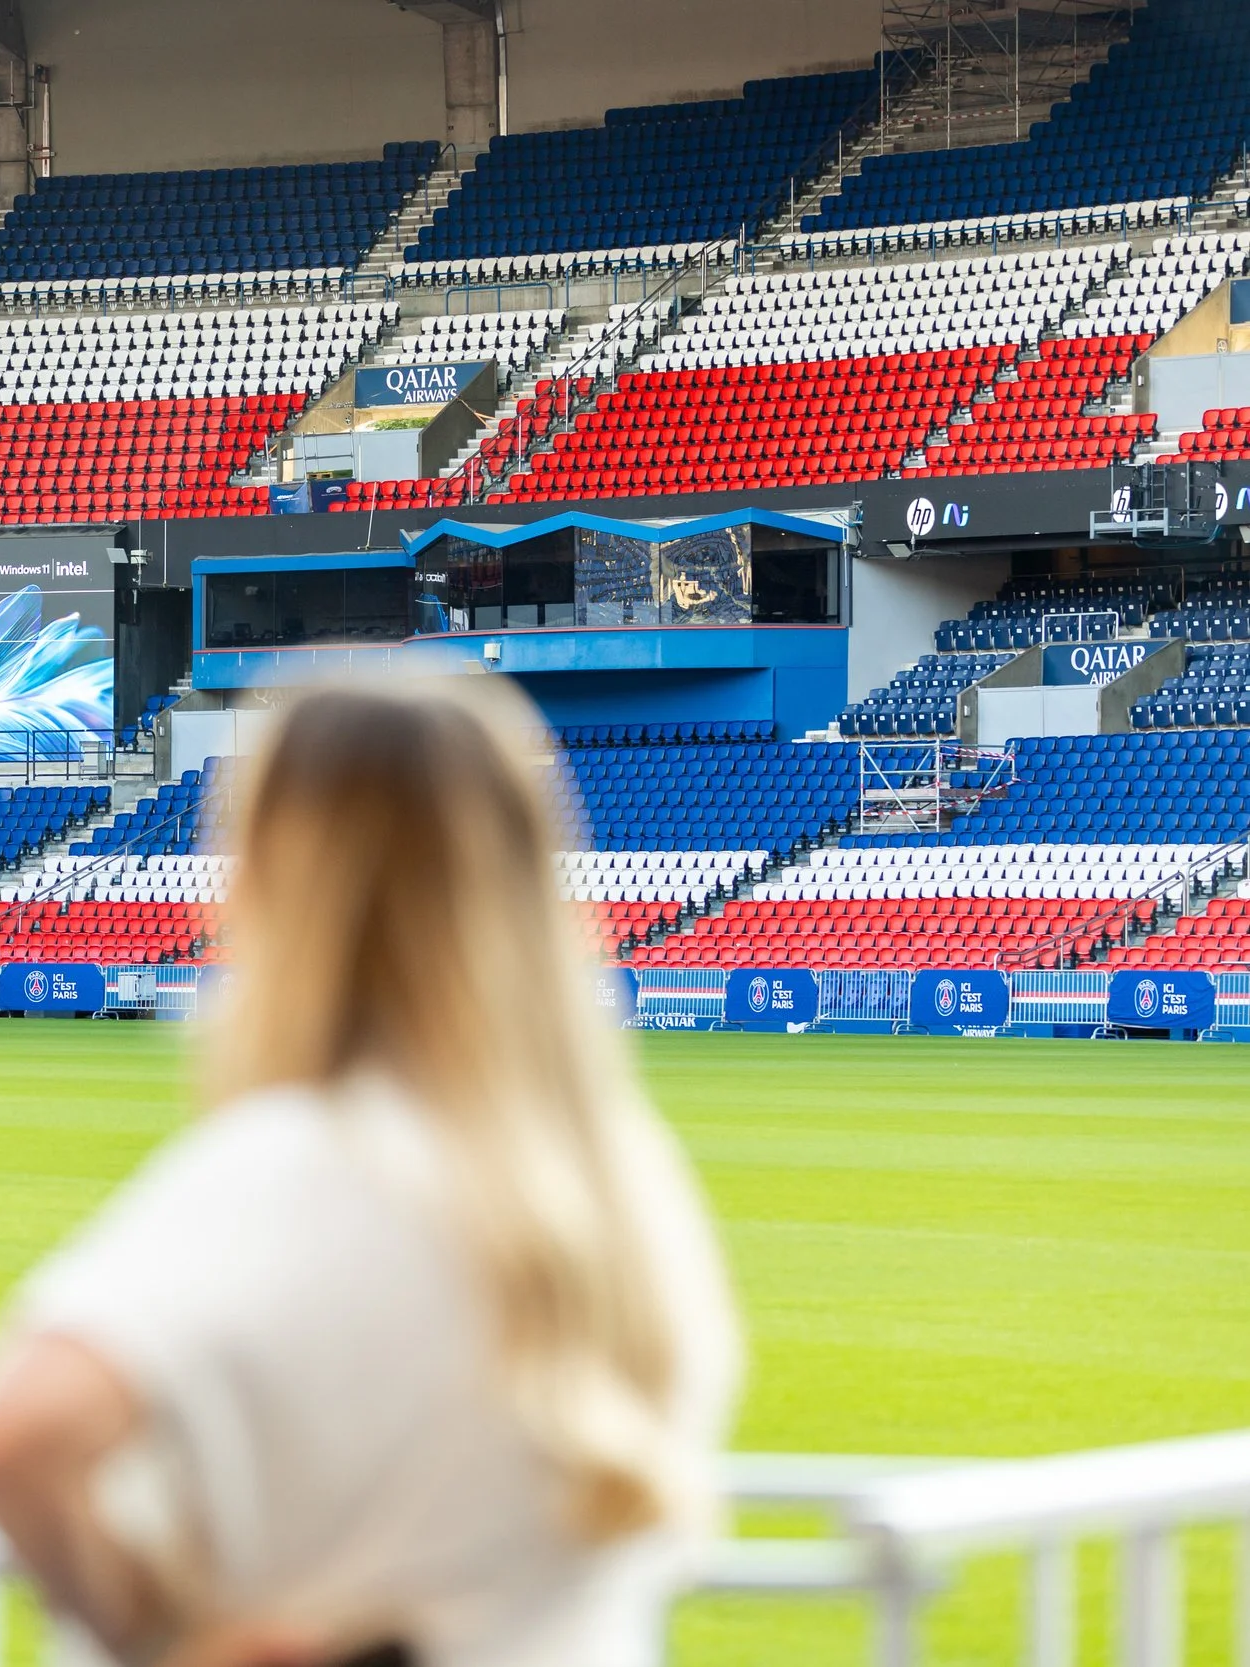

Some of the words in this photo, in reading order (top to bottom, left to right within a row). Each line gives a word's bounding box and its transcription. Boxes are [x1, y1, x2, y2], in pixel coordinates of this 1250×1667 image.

[386, 366, 457, 394] QATAR
[403, 387, 457, 403] AIRWAYS
[910, 498, 933, 535] hp
[0, 564, 41, 575] Windows
[42, 564, 50, 574] 11
[1070, 645, 1146, 676] QATAR
[53, 974, 64, 982] ICI
[53, 982, 76, 991] C'EST
[772, 981, 783, 989] ICI
[960, 983, 971, 992] ICI
[1163, 984, 1174, 993] ICI
[53, 991, 78, 999] PARIS
[772, 990, 793, 999] C'EST
[960, 993, 982, 1002] C'EST
[1163, 995, 1186, 1004] C'EST
[772, 1000, 794, 1009] PARIS
[960, 1003, 983, 1012] PARIS
[1162, 1005, 1188, 1014] PARIS
[655, 1013, 696, 1029] QATAR
